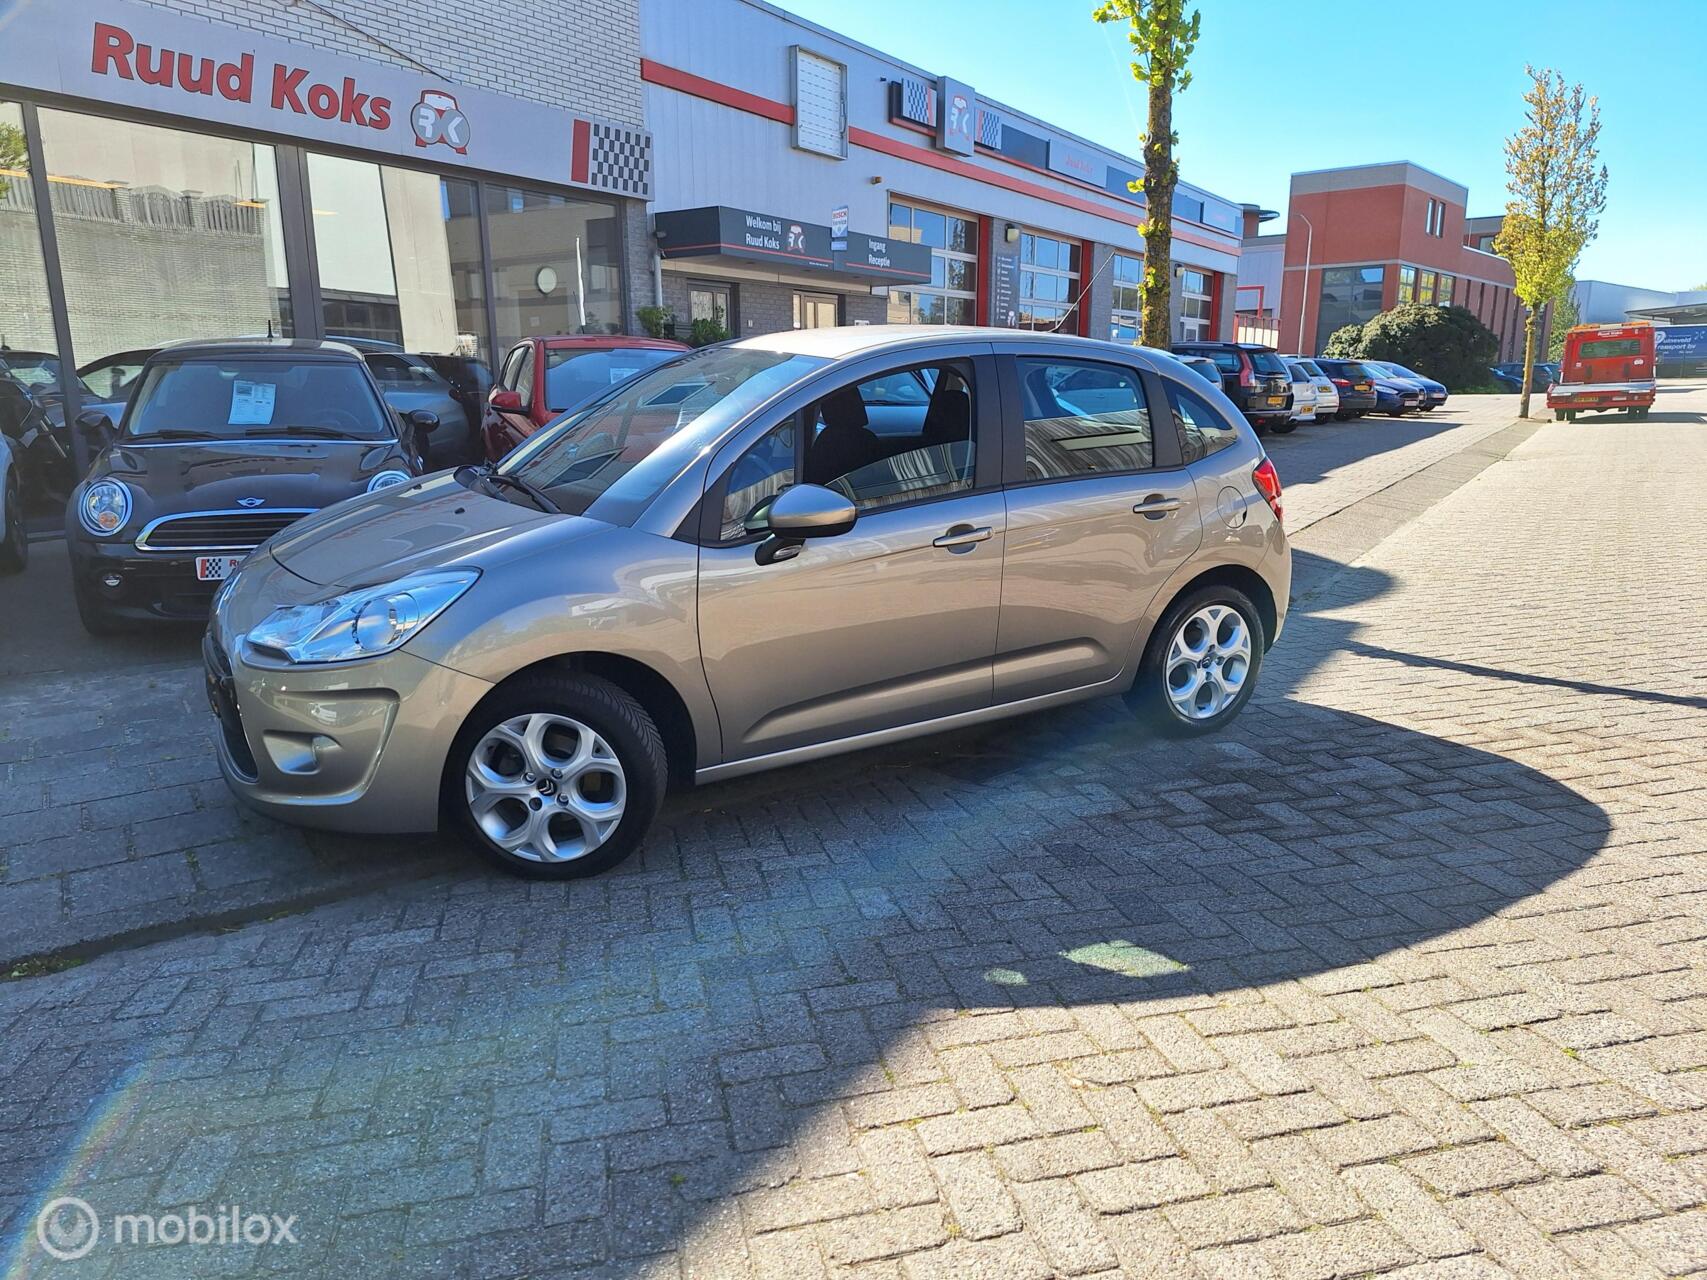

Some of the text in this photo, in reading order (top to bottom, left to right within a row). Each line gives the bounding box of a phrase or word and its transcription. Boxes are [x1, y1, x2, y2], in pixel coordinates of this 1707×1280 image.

[91, 21, 392, 130] Ruud Koks
[745, 215, 782, 235] Welkom bij
[745, 233, 780, 250] Ruud Koks
[868, 238, 886, 253] Ingang
